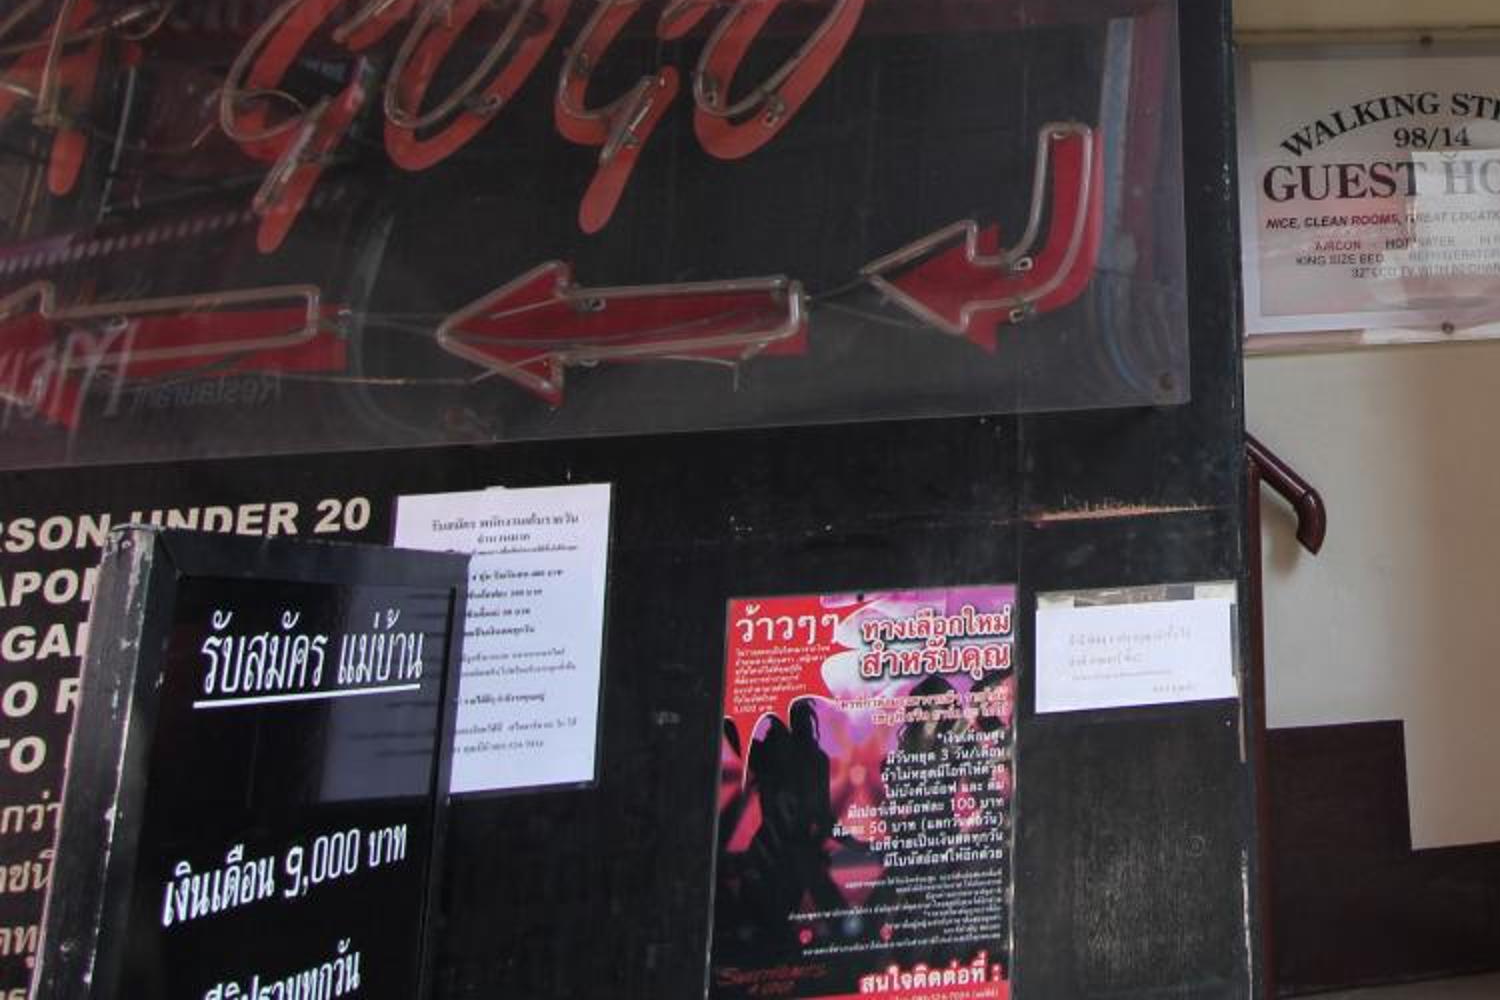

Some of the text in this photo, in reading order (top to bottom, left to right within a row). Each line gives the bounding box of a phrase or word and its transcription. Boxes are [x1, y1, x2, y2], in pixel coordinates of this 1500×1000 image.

[1279, 92, 1441, 158] WALKING
[1393, 126, 1471, 150] 98/14
[1262, 160, 1427, 204] GUEST
[1303, 216, 1349, 228] CLEAN
[1385, 237, 1410, 250] HOT
[0, 513, 112, 552] SON
[313, 496, 372, 534] 20
[0, 564, 98, 609] PO
[200, 608, 425, 696] รับสมัคร แม่บ้าน
[941, 749, 949, 760] 3
[950, 796, 976, 811] 100
[869, 821, 888, 834] 50
[161, 823, 408, 928] เงินเดือน 9,000 บาท
